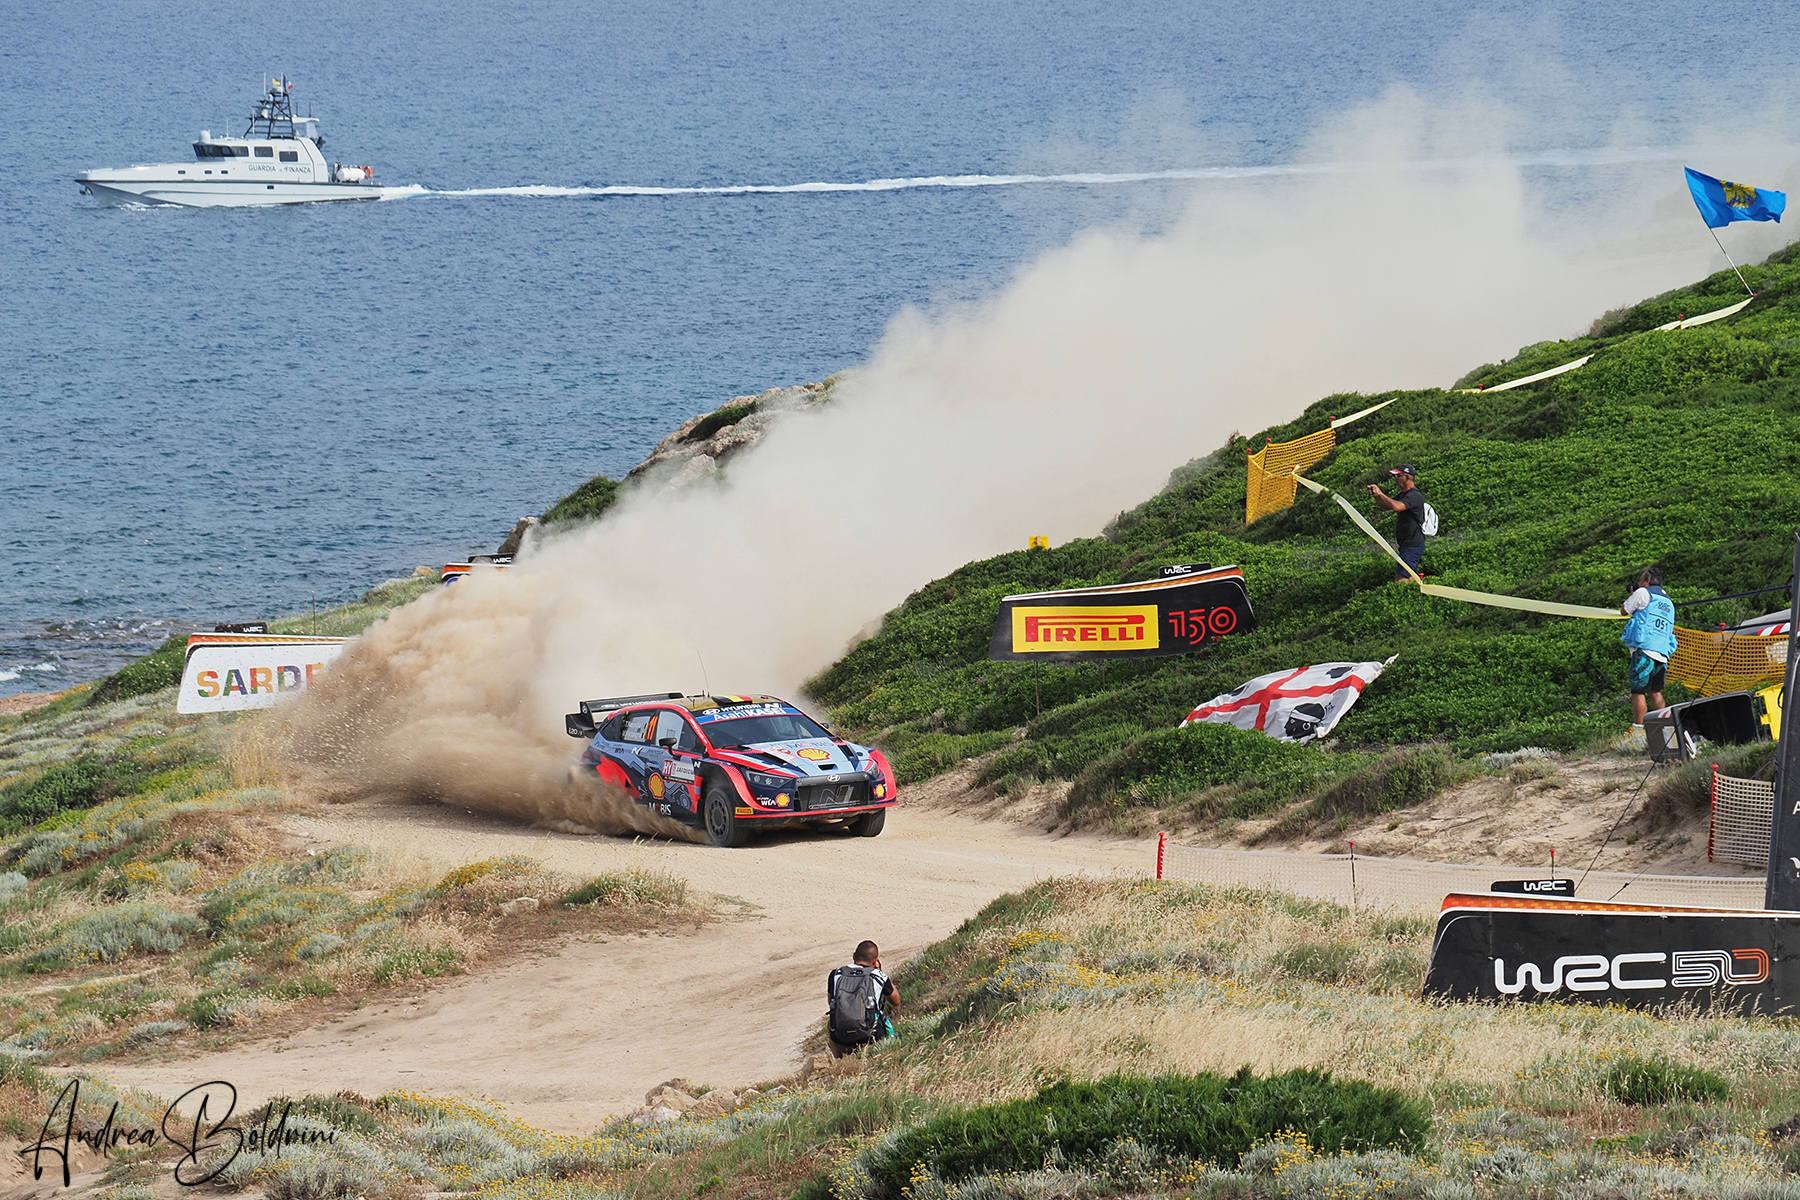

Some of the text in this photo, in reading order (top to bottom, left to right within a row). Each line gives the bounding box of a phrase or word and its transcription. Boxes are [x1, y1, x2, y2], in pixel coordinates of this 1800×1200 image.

[248, 164, 276, 172] GUARDIA
[1164, 565, 1192, 575] WRC
[1025, 614, 1146, 643] PIRELLI
[1168, 606, 1238, 645] 150
[1655, 619, 1668, 631] 051
[721, 704, 762, 712] HYUNDAI
[1523, 880, 1567, 892] WRC
